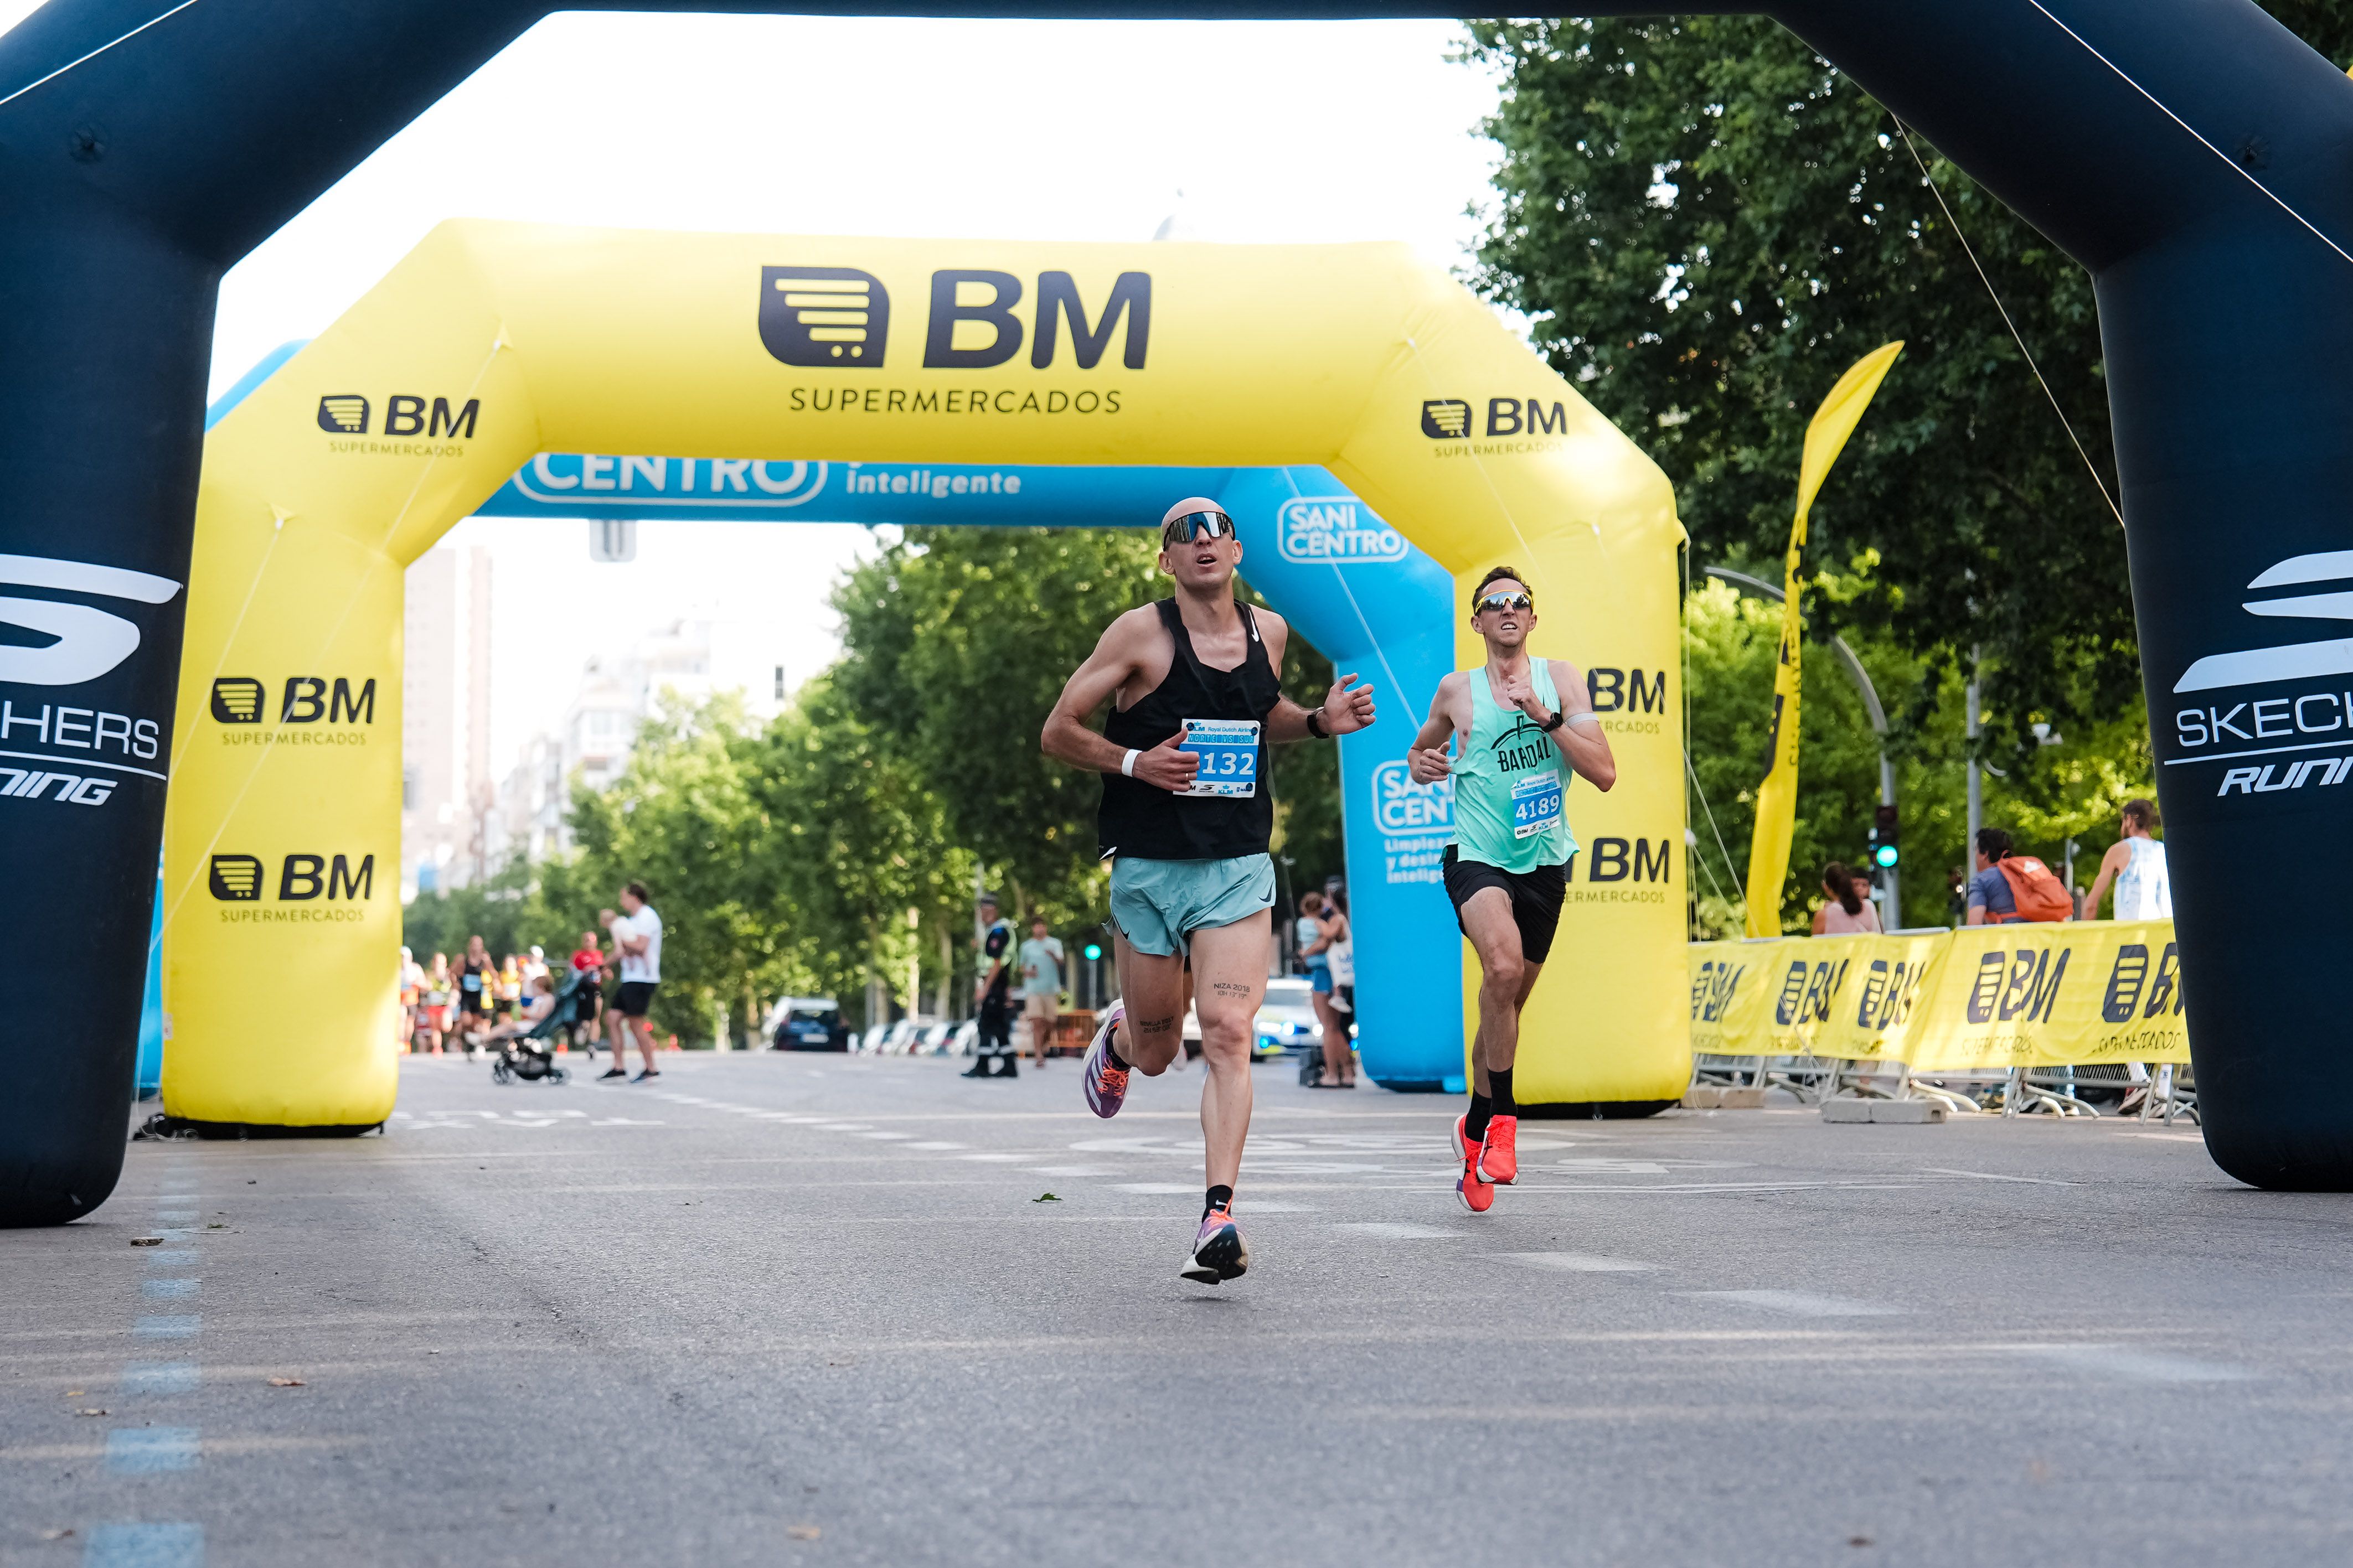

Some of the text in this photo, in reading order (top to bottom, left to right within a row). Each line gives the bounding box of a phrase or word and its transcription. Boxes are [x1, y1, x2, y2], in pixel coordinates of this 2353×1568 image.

[922, 269, 1152, 370] BM
[384, 395, 481, 438] BM
[790, 388, 1122, 414] SUPERMERCADOS
[1487, 397, 1567, 436] BM
[329, 441, 464, 457] SUPERMERCADOS
[1434, 442, 1563, 458] SUPERMERCADOS
[534, 452, 808, 494] CENTRO
[846, 469, 1021, 498] inteligente
[1288, 505, 1356, 531] SANI
[1287, 529, 1402, 556] CENTRO
[281, 677, 375, 724] BM
[1587, 668, 1665, 715] BM
[0, 701, 159, 759] HERS
[2176, 692, 2353, 747] SKEC
[222, 732, 367, 746] SUPERMERCADOS
[1188, 734, 1255, 743] NORTE VS SUR
[1497, 736, 1551, 772] BARDAL
[1202, 752, 1254, 775] 132
[0, 768, 118, 806] NING
[1515, 794, 1560, 820] 4189
[278, 855, 374, 901] BM
[1590, 837, 1669, 883] BM
[1566, 891, 1665, 903] ERMERCADOS
[220, 908, 365, 923] SUPERMERCADOS
[1999, 948, 2071, 1023] BM
